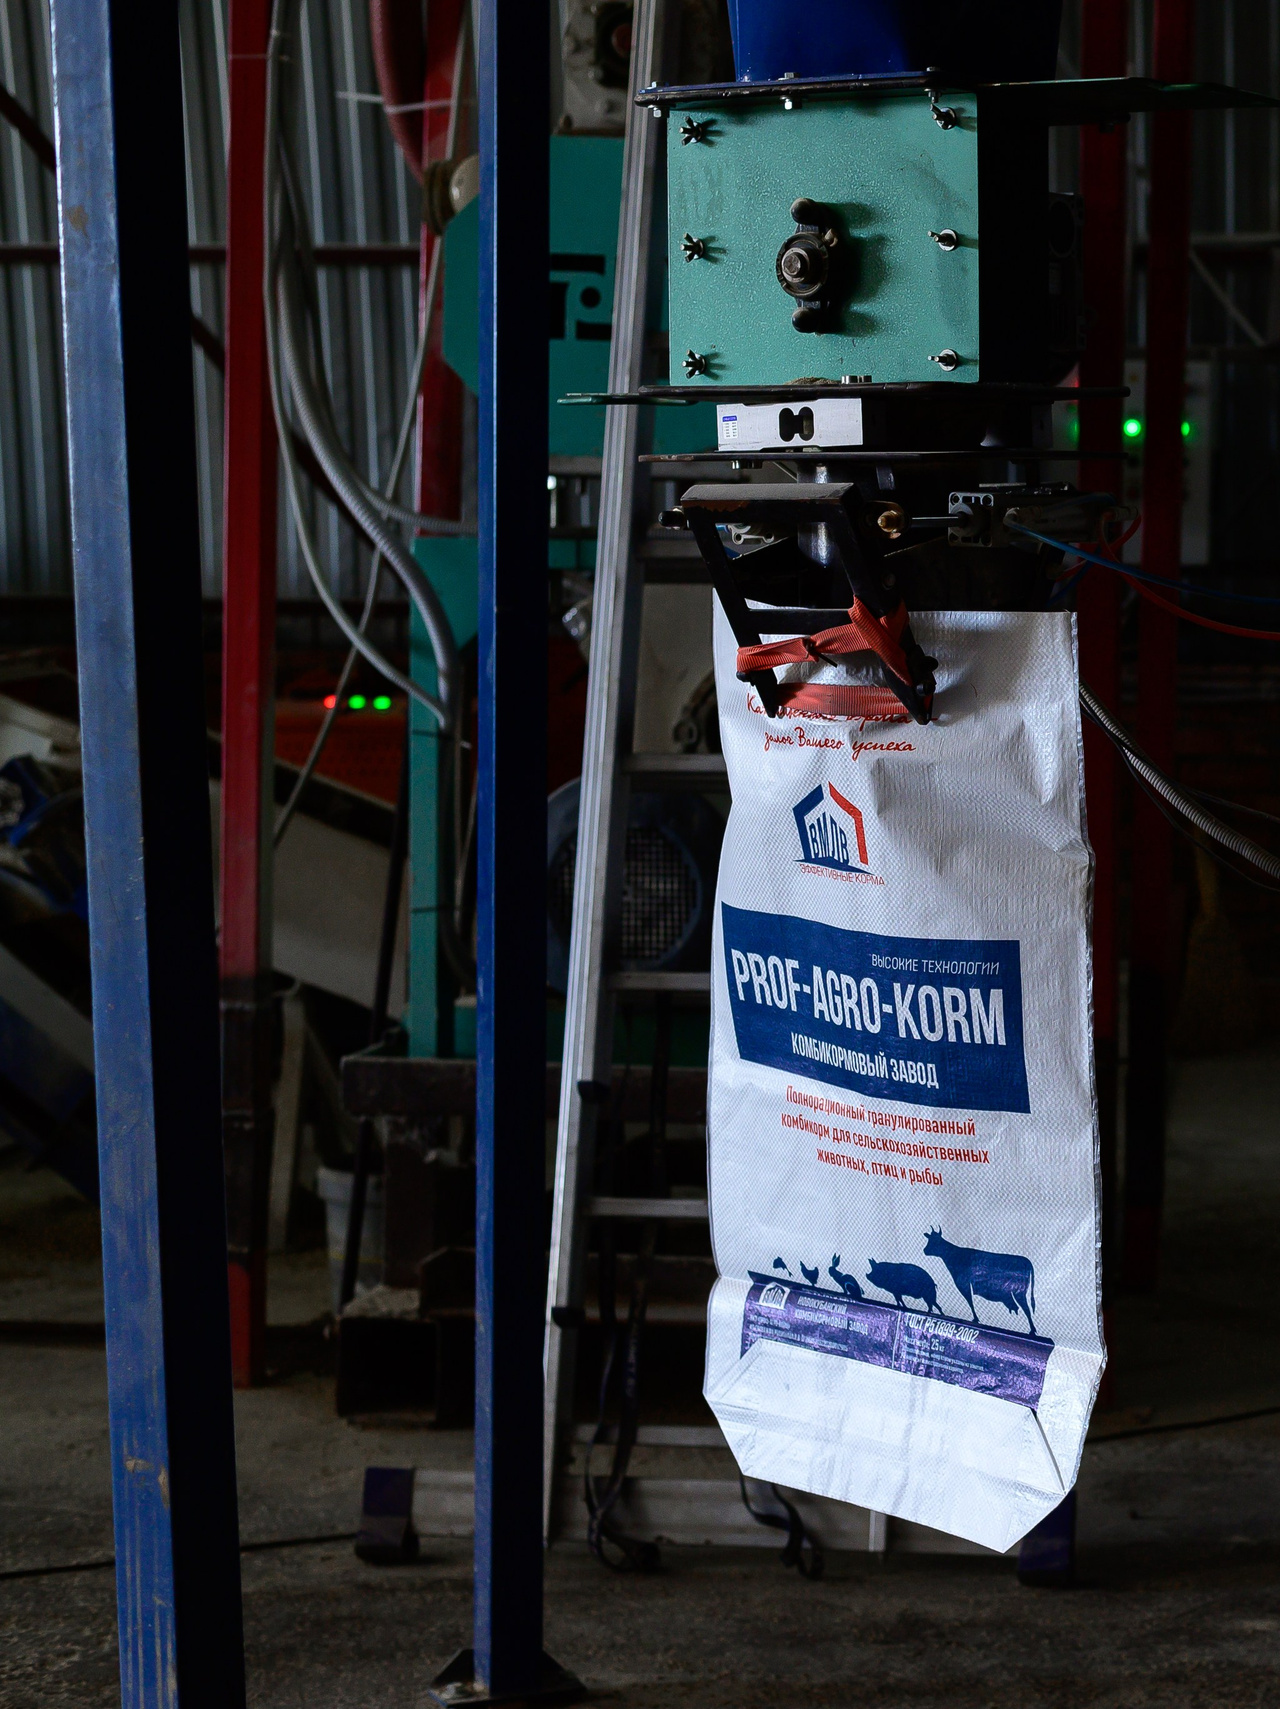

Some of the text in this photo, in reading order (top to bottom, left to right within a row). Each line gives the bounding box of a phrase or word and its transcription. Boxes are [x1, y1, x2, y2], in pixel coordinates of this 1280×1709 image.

[764, 726, 917, 761] залог Вашего успеха
[799, 863, 885, 886] ЭФФЕКТИВНЫЕ КОРМА
[871, 953, 1000, 976] ВЫСОКИЕ ТЕХНОЛОГИИ
[731, 948, 1007, 1046] PROF-AGRO-KORM
[791, 1032, 940, 1089] КОМБИКОРМОВЫЙ ЗАВОД
[786, 1085, 976, 1136] Полнорационный гранулированный
[781, 1113, 990, 1164] комбикорм для сельскохозяйственных
[817, 1148, 943, 1186] животных, птиц и рыбы
[930, 1338, 940, 1352] 25
